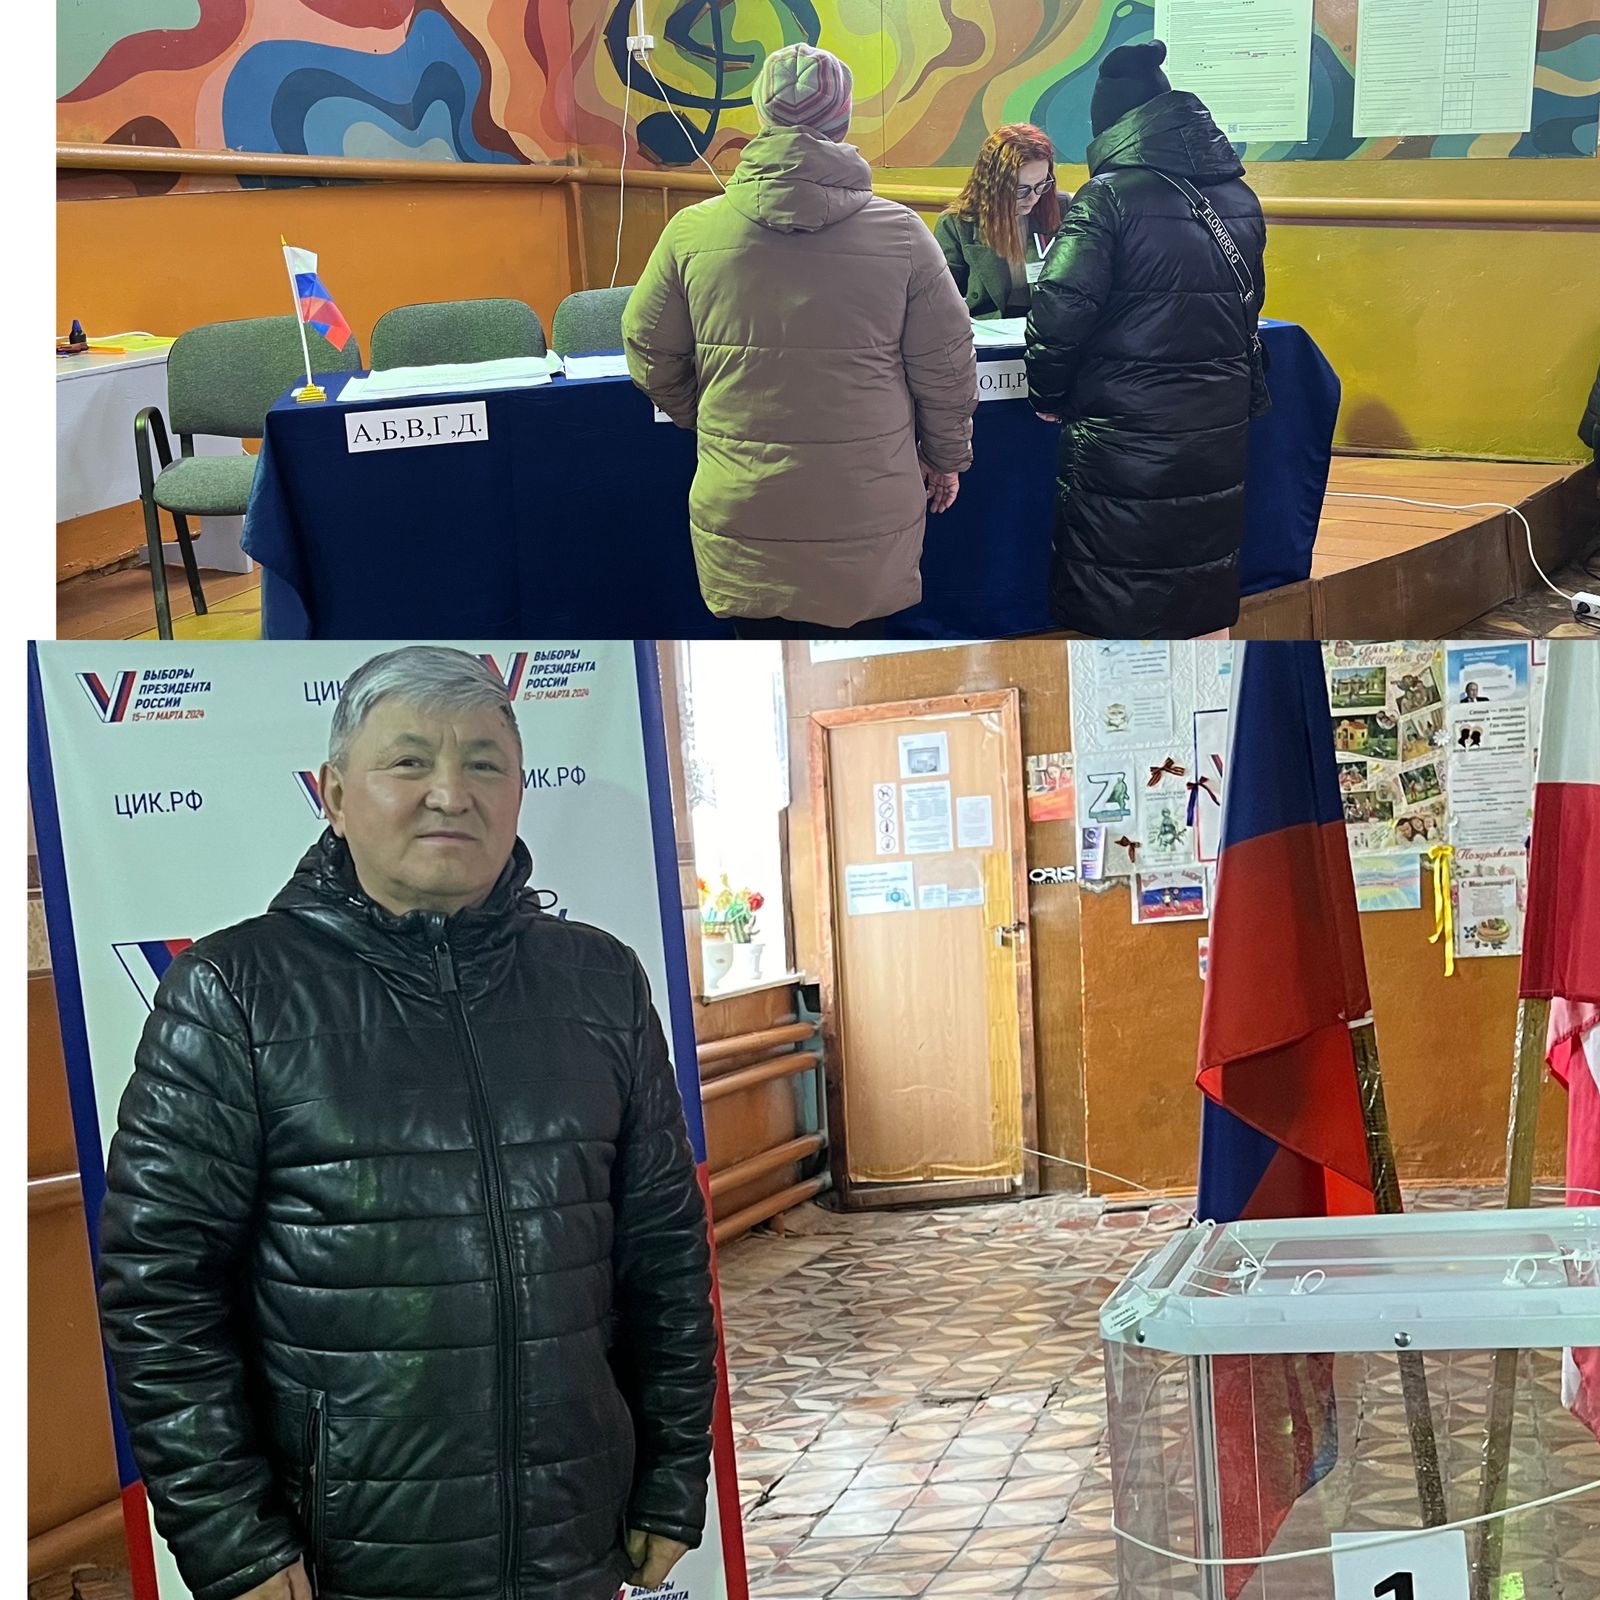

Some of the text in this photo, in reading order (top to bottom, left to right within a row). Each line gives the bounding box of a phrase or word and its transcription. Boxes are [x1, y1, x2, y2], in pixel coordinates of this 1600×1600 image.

[533, 649, 581, 662] ВЫБОРЫ
[142, 668, 195, 681] ВЫБОРЫ
[529, 661, 597, 676] ПРЕЗИДЕНТА
[138, 681, 212, 696] ПРЕЗИДЕНТА
[525, 677, 569, 689] РОССИИ
[544, 689, 571, 700] МАРТА
[571, 688, 590, 698] 2024
[134, 696, 182, 710] РОССИИ
[155, 710, 184, 721] МАРТА
[184, 709, 205, 720] 2024
[114, 790, 203, 819] ЦИК.РФ
[1029, 865, 1076, 884] ORIS
